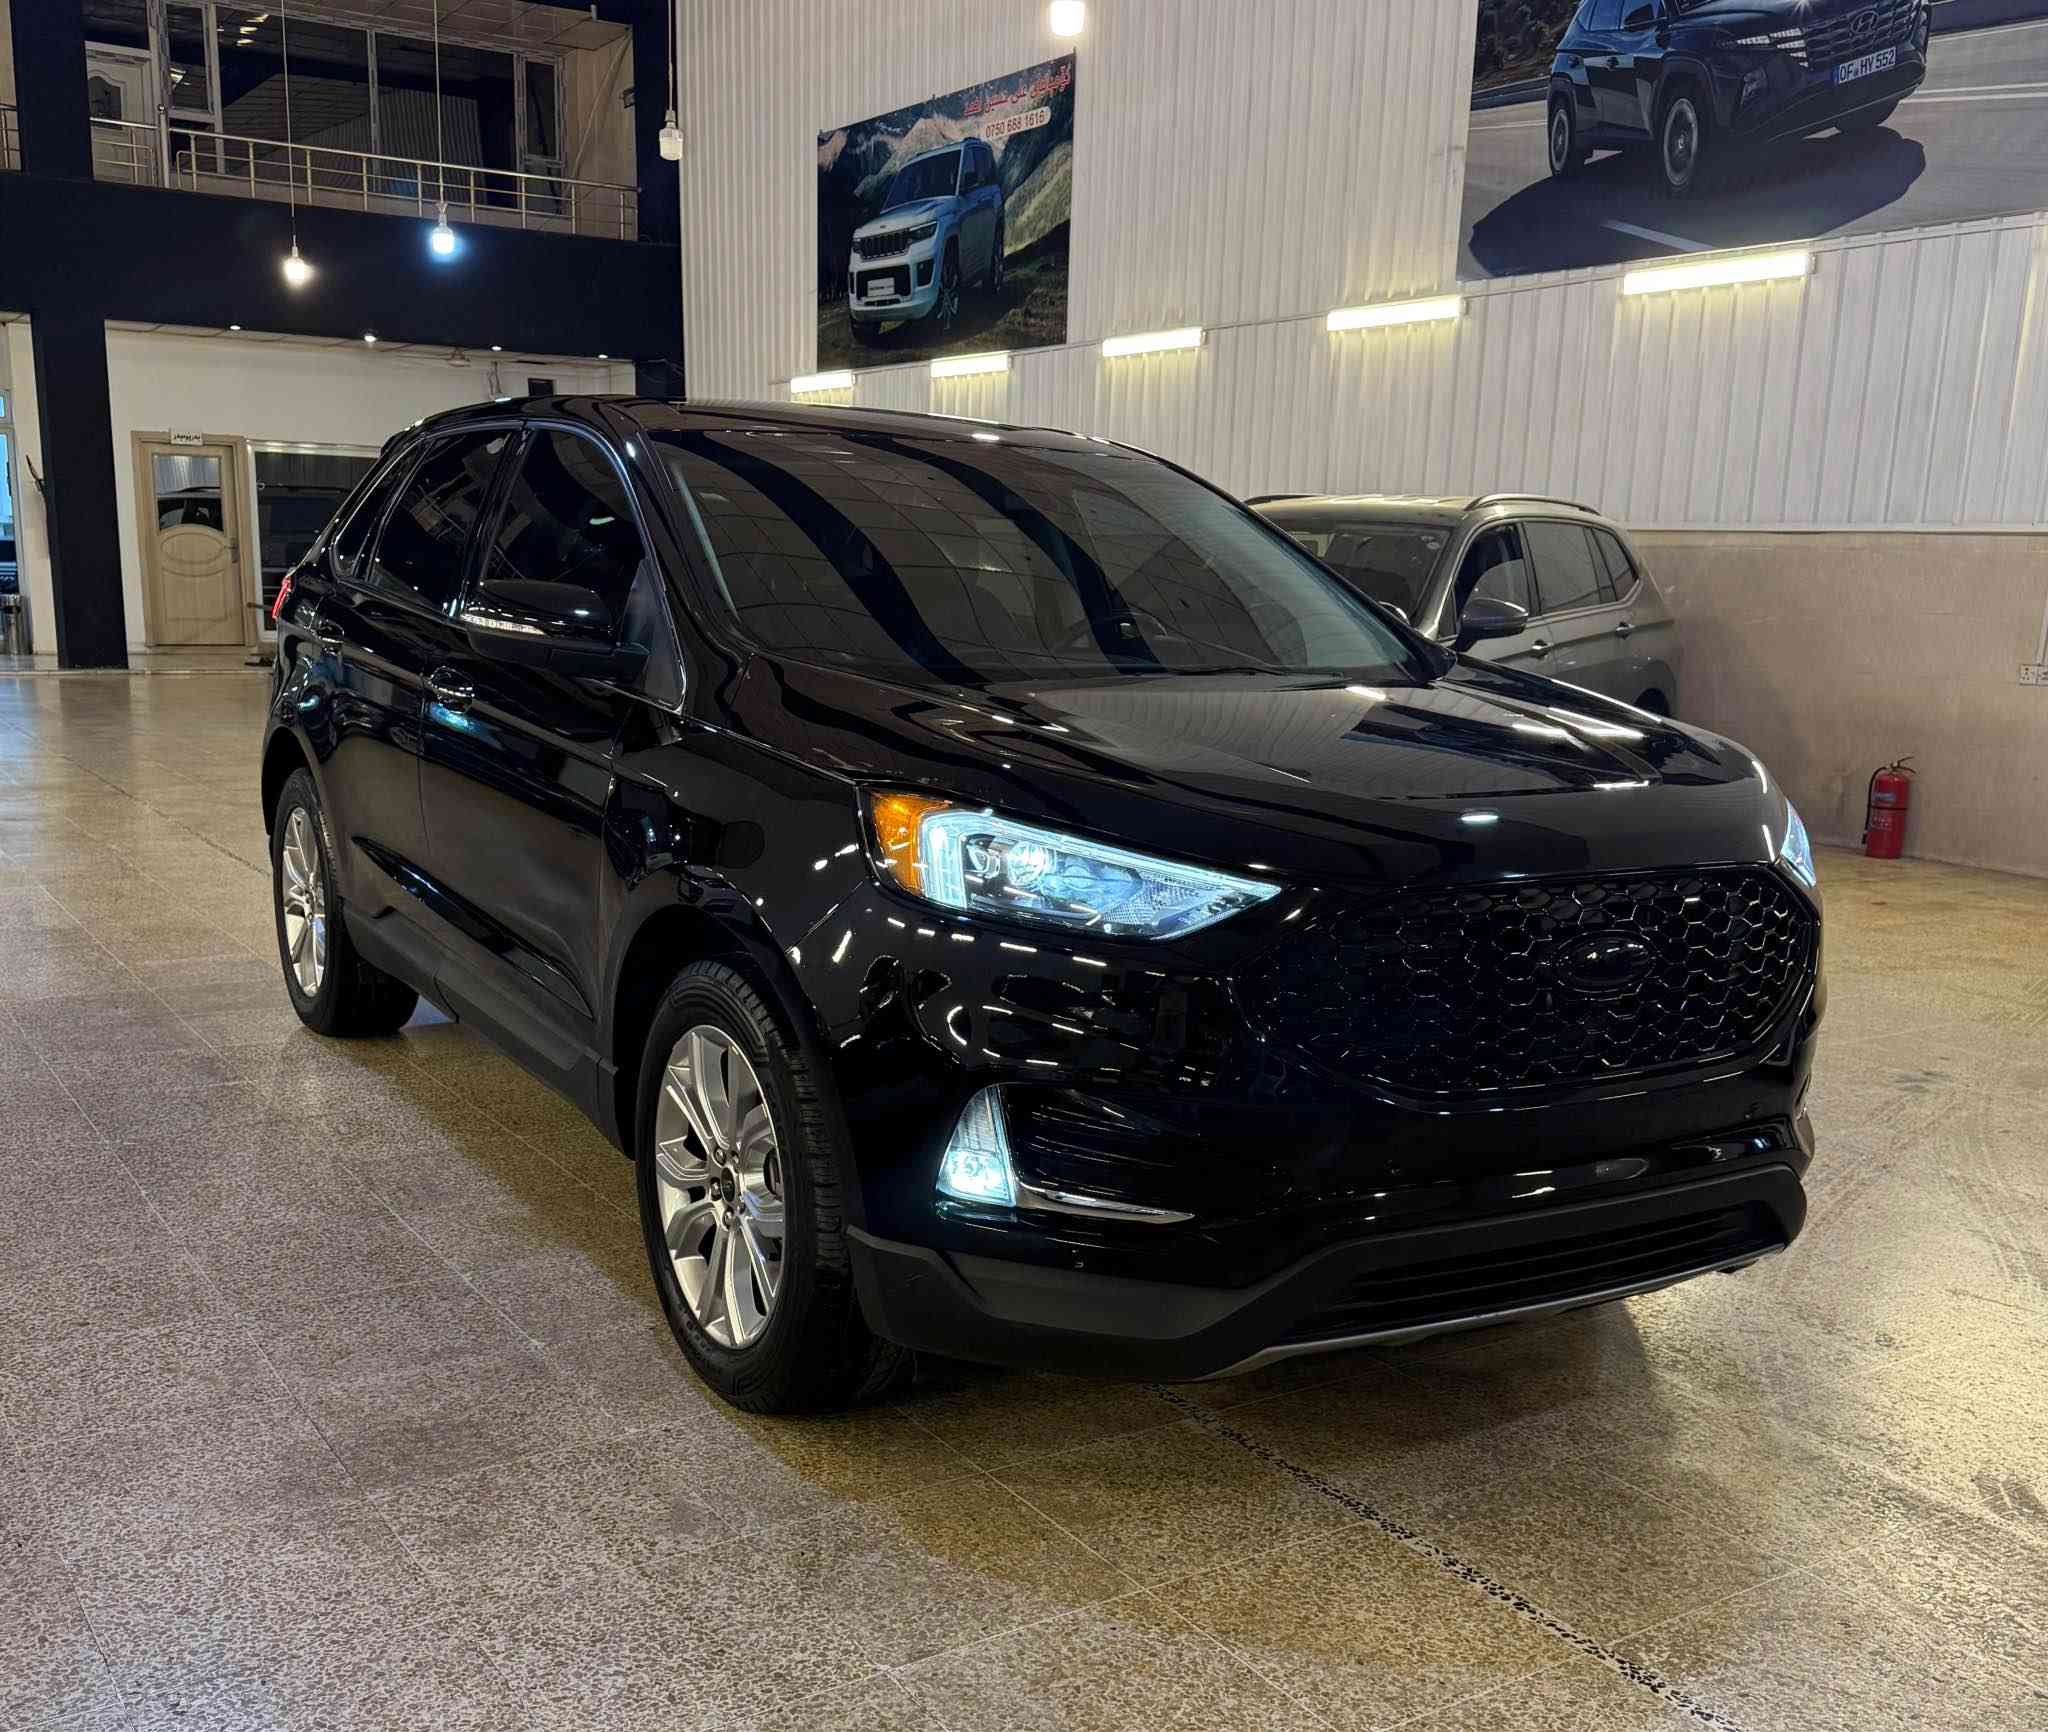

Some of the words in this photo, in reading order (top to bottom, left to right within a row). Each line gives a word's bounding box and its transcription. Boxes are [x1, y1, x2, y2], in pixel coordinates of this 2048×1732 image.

[1860, 55, 1873, 76] HY
[1875, 49, 1895, 69] 552
[985, 121, 1005, 138] 0750
[1025, 110, 1045, 127] 1616
